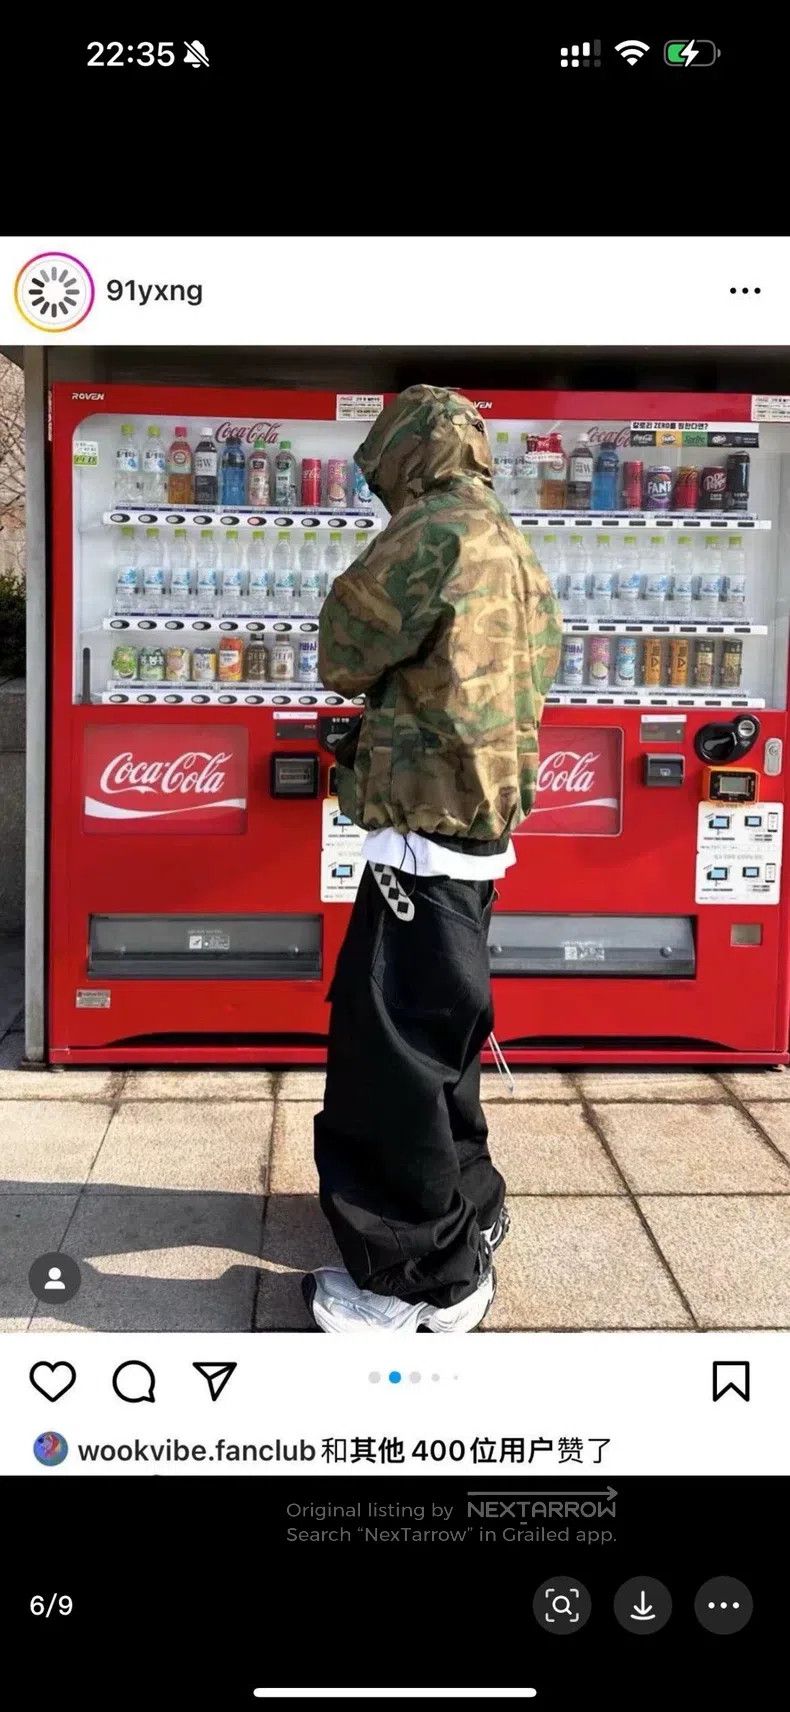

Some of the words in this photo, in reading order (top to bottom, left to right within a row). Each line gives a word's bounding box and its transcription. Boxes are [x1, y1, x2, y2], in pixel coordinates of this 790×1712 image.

[71, 392, 105, 400] ROVEN
[473, 401, 493, 409] VEN
[100, 751, 234, 795] Coca-Cola
